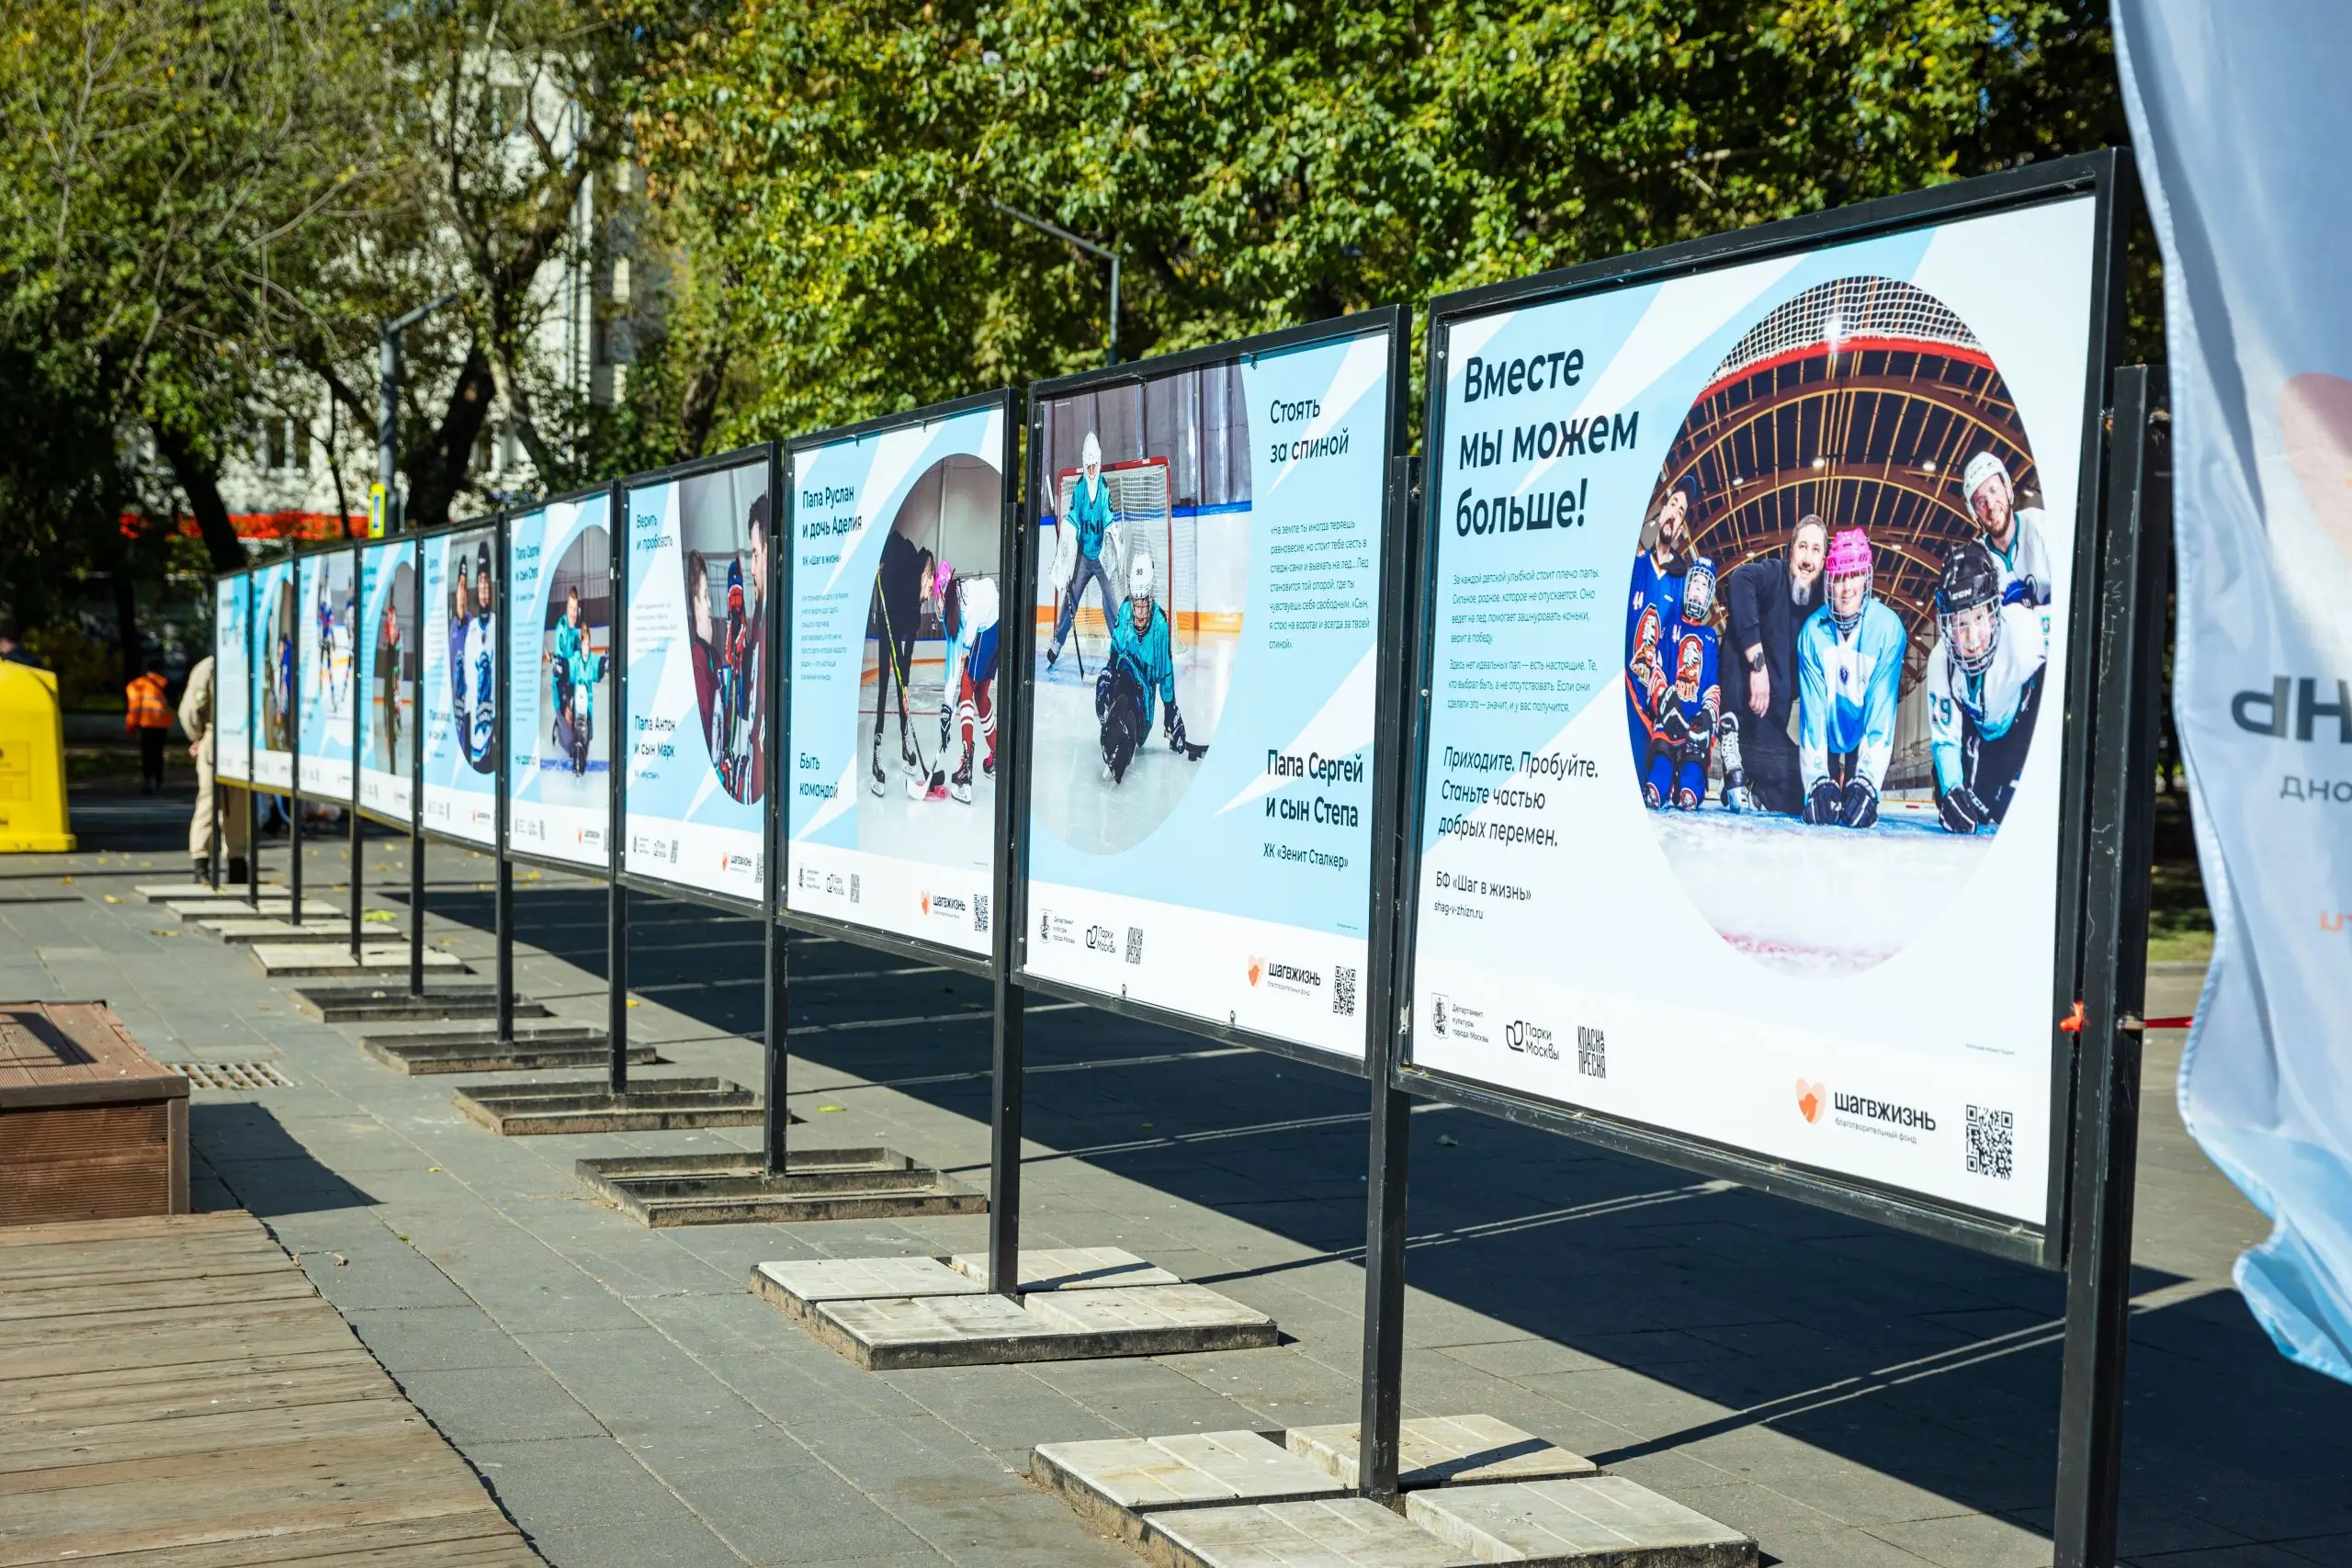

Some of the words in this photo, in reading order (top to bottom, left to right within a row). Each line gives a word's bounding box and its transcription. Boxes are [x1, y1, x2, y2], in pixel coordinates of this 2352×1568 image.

[1464, 349, 1584, 402] Вместе
[1271, 399, 1320, 424] Стоять
[1271, 443, 1287, 463] за
[1292, 427, 1349, 460] спиной
[1460, 430, 1502, 470] мы
[1513, 411, 1639, 463] можем
[802, 491, 823, 509] Папа
[825, 486, 854, 510] Руслан
[1456, 479, 1588, 536] больше!
[802, 524, 808, 538] и
[809, 521, 831, 540] дочь
[831, 515, 862, 536] Аделия
[1331, 538, 1345, 549] тебе
[1302, 581, 1311, 591] той
[1337, 581, 1346, 590] где
[1347, 580, 1355, 589] ты
[1508, 570, 1535, 584] улыбкой
[1536, 570, 1555, 581] стоит
[1556, 570, 1577, 580] плечо
[1579, 569, 1600, 579] папы.
[1303, 599, 1316, 610] себя
[1502, 592, 1527, 604] которое
[1529, 592, 1537, 602] не
[1538, 591, 1578, 604] опускается.
[1580, 588, 1595, 600] Оно
[1488, 613, 1516, 623] помогает
[1518, 612, 1561, 625] зашнуровать
[1563, 612, 1589, 623] коньки,
[1450, 659, 1464, 671] Здесь
[1465, 661, 1476, 670] нет
[1476, 661, 1508, 671] идеальных
[1509, 661, 1521, 670] пап
[1530, 661, 1544, 671] есть
[1546, 661, 1586, 671] настоящие.
[1588, 659, 1598, 672] Те,
[1448, 680, 1457, 689] кто
[1500, 681, 1508, 690] не
[1557, 680, 1574, 692] Если
[1576, 682, 1590, 692] они
[1520, 702, 1532, 711] вас
[1532, 702, 1570, 715] получится.
[635, 715, 653, 731] Папа
[799, 752, 820, 771] Быть
[1267, 750, 1304, 778] Папа
[1308, 751, 1363, 787] Сергей
[1443, 746, 1515, 773] Приходите.
[1520, 751, 1599, 781] Пробуйте.
[799, 781, 839, 801] командой
[1442, 779, 1489, 804] Станьте
[1493, 787, 1545, 810] частью
[1266, 797, 1275, 818] и
[1280, 798, 1309, 822] сын
[1314, 796, 1359, 828] Степа
[1438, 814, 1487, 840] добрых
[1489, 822, 1558, 847] перемен.
[1263, 842, 1275, 858] ХК
[1277, 845, 1307, 863] «Зенит
[1308, 849, 1349, 871] Сталкер»
[1436, 871, 1451, 888] БФ
[1453, 874, 1478, 894] «Шаг
[1481, 881, 1487, 895] в
[1489, 882, 1532, 901] жизнь»
[1434, 900, 1484, 919] shag-v-zhizn.ru
[1452, 1004, 1484, 1018] Департамент
[1452, 1017, 1475, 1029] культуры
[1525, 1022, 1552, 1044] Парки
[1452, 1029, 1469, 1040] города
[1470, 1032, 1489, 1043] Москвы
[1525, 1043, 1560, 1061] Москвы
[1578, 1051, 1606, 1079] ПРЕСНЯ
[1835, 1117, 1898, 1140] благотворительный
[1899, 1130, 1917, 1145] фонд
